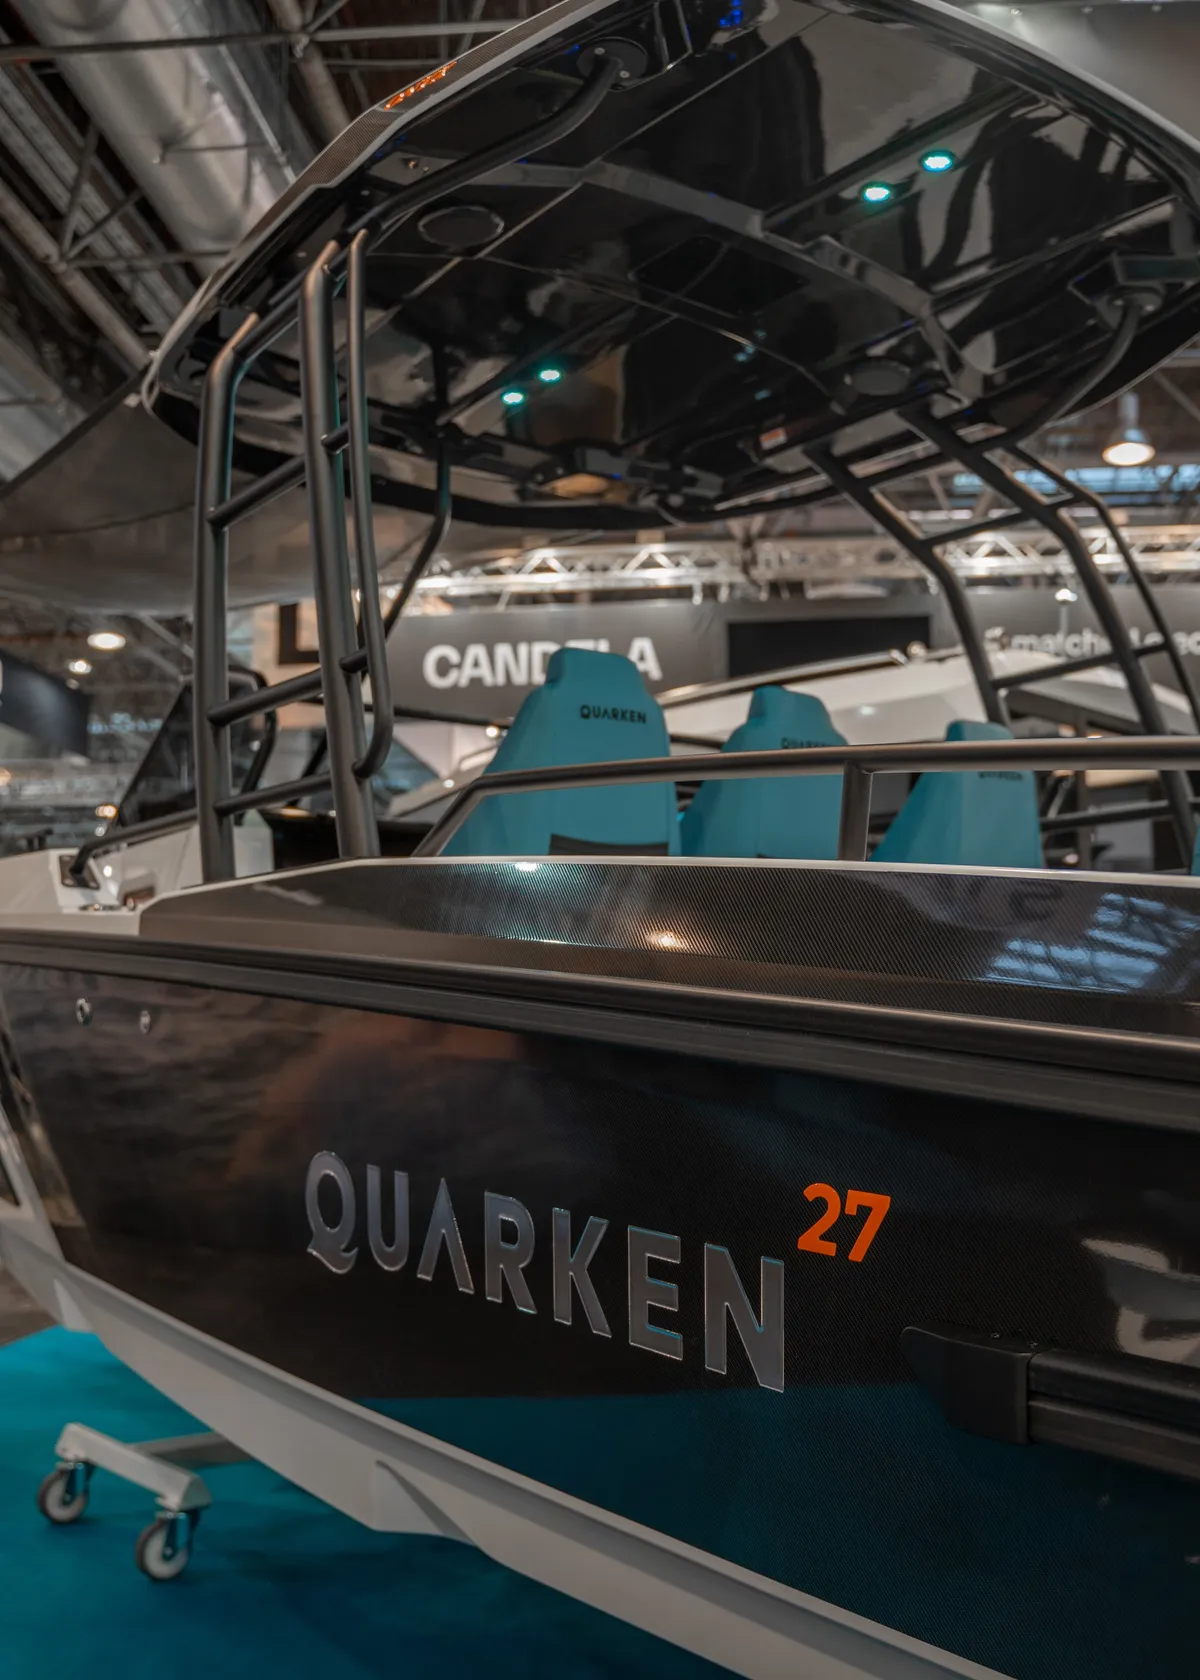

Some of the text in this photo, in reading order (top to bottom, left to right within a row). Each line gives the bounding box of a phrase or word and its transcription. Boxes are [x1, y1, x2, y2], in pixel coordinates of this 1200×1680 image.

[422, 637, 663, 689] CANDA
[580, 705, 647, 724] QUARKEN
[305, 1150, 891, 1393] QUARKEN 27
